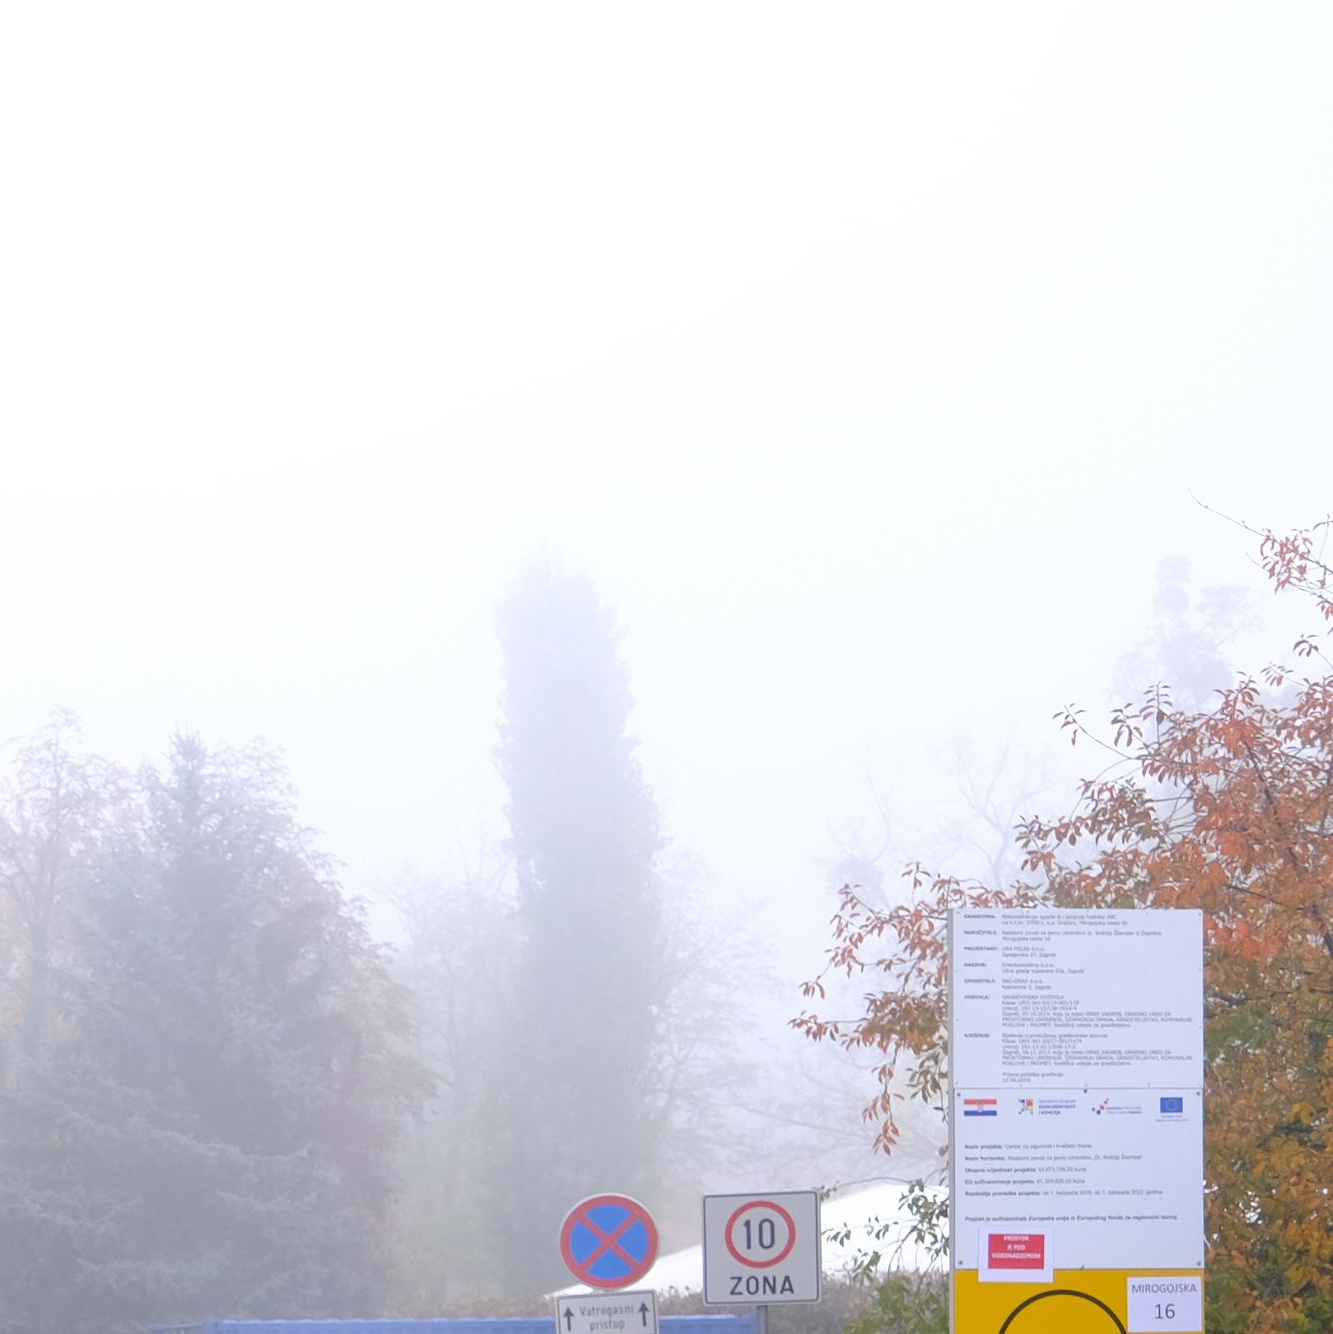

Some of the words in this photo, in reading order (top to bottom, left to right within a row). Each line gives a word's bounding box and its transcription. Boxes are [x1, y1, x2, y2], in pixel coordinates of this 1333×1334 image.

[743, 1218, 775, 1250] 10
[729, 1275, 794, 1296] ZONA
[1131, 1283, 1197, 1294] MIROGOJSKA
[579, 1302, 635, 1318] Vatrogasni
[1154, 1303, 1175, 1320] 16
[589, 1317, 626, 1333] pristup
